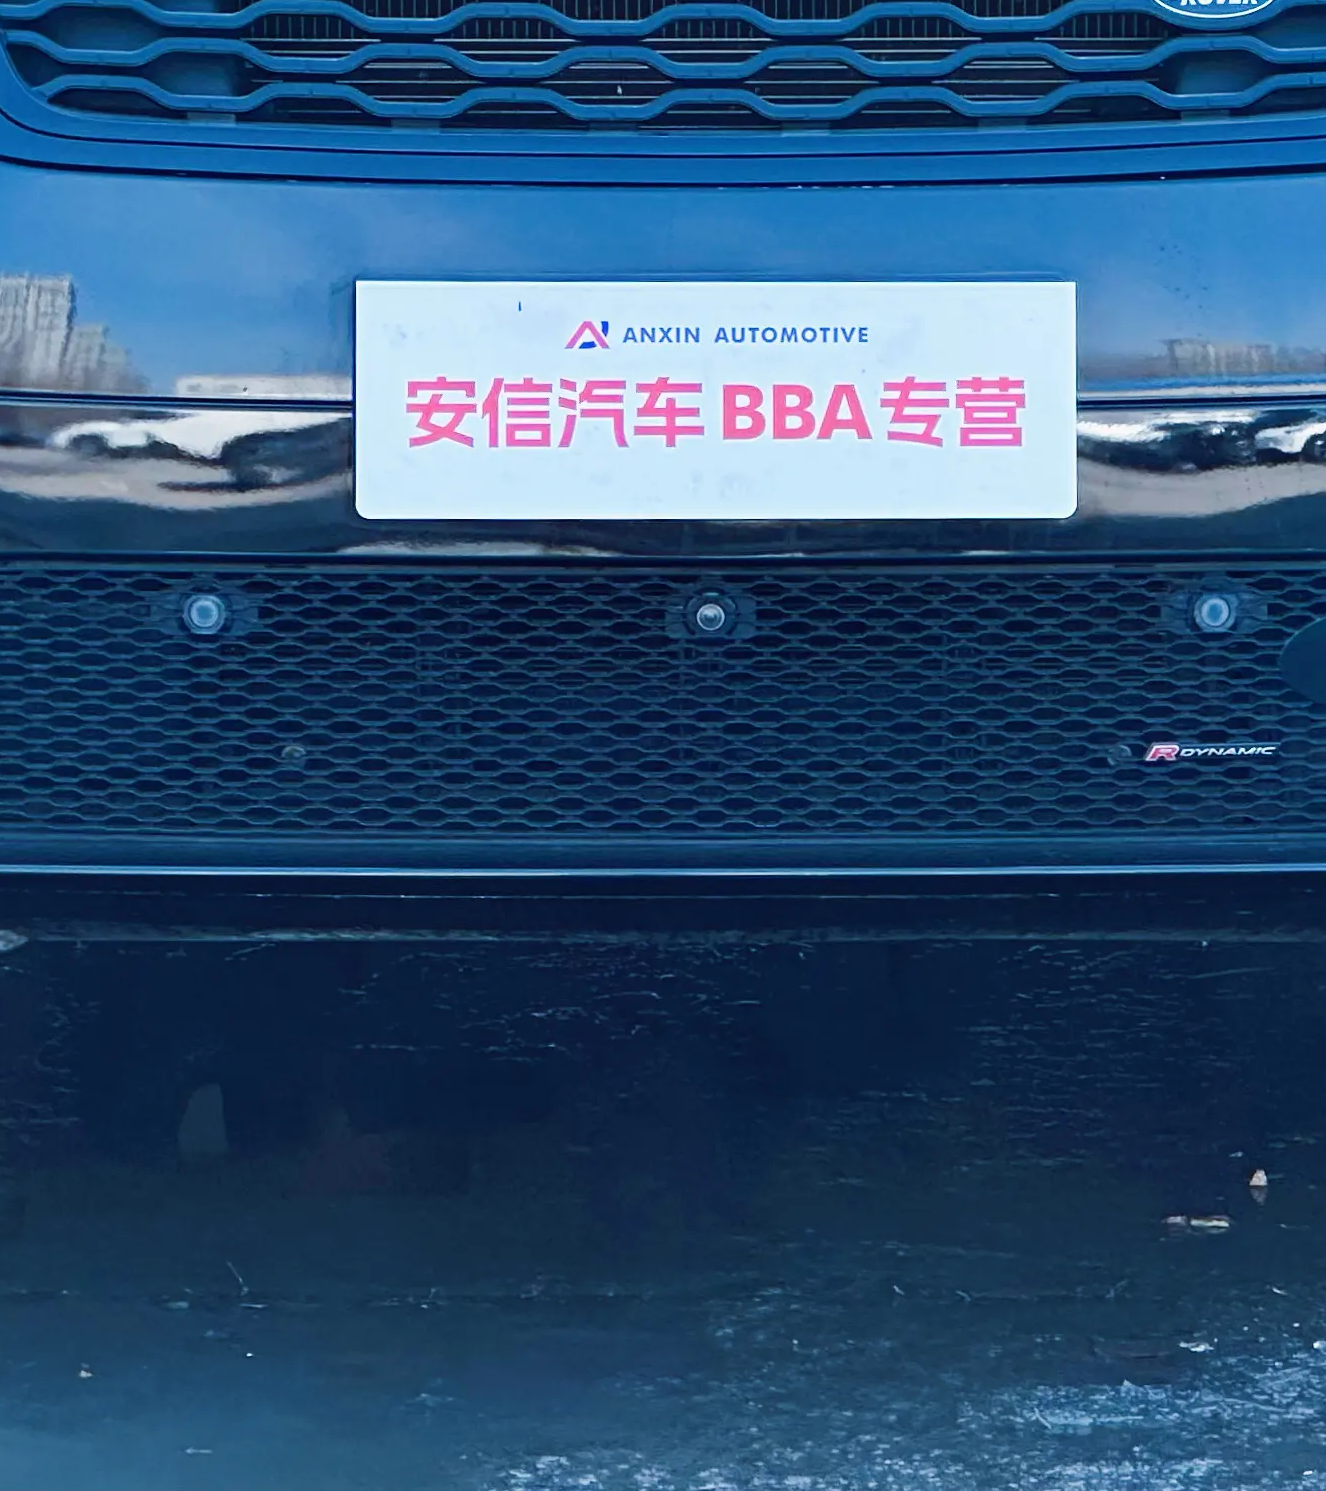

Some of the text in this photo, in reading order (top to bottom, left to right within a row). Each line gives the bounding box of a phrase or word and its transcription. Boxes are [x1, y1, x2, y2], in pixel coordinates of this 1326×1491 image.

[622, 326, 869, 344] ANXIN AUTOMOTIVE
[1179, 746, 1276, 757] DYNAMIC
